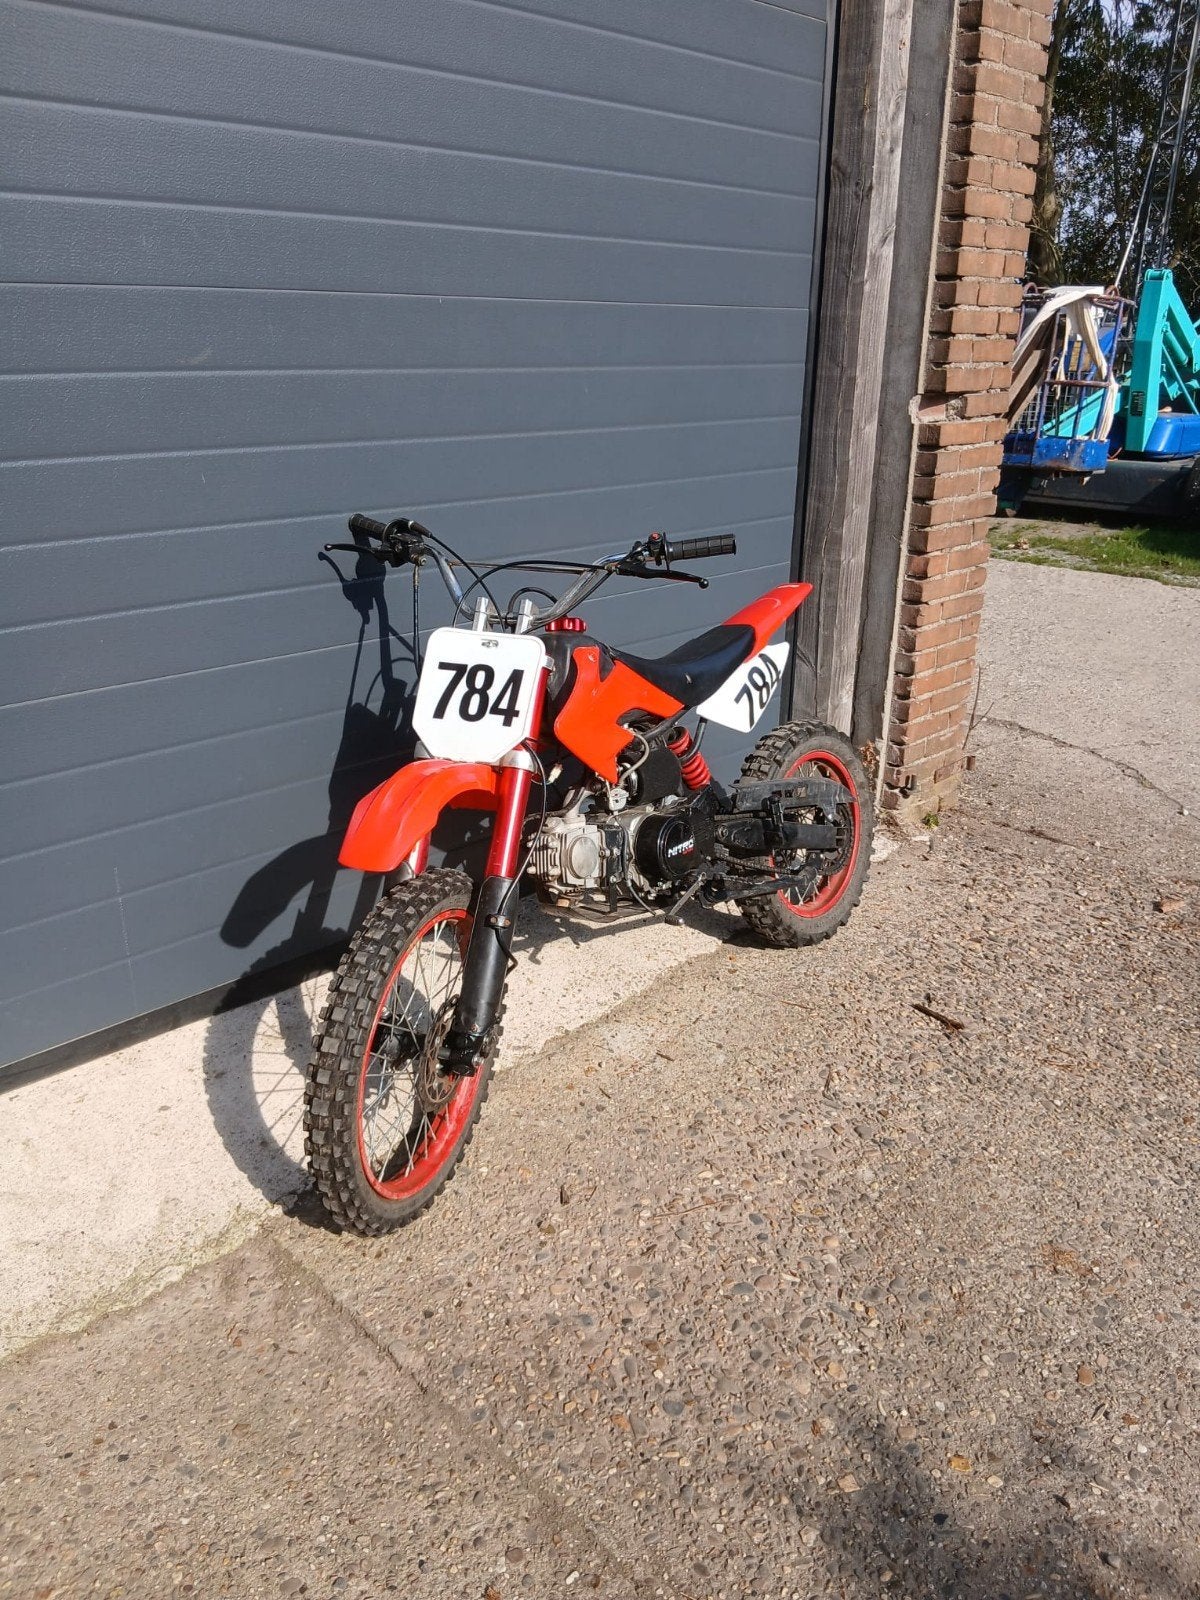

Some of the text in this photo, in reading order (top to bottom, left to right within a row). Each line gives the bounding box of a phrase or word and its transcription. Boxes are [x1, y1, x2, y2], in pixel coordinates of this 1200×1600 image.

[432, 661, 525, 728] 784
[734, 653, 781, 730] 784
[668, 838, 695, 858] NITRO
